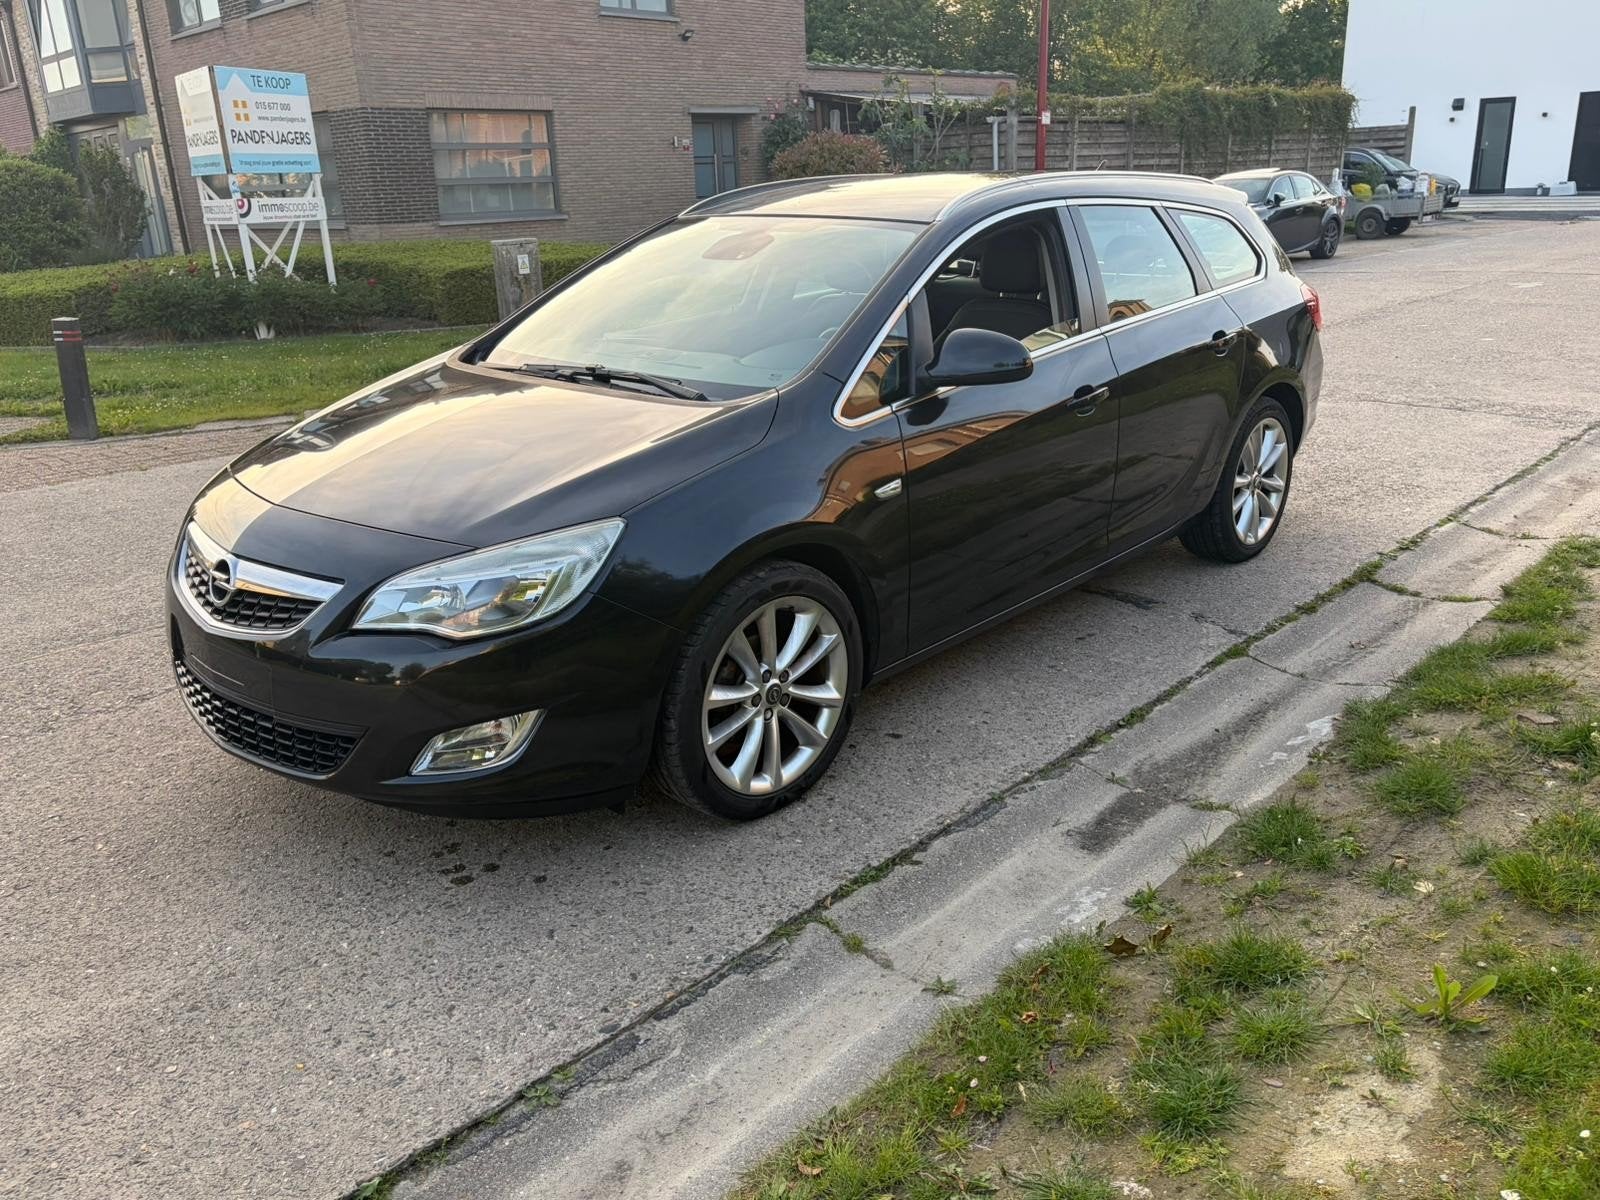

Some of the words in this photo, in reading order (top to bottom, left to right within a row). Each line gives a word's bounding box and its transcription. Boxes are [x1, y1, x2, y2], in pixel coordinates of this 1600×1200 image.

[250, 74, 263, 88] TE
[264, 76, 291, 90] KOOP
[255, 101, 267, 110] 015
[267, 102, 279, 111] 677
[280, 103, 291, 112] 000
[257, 115, 306, 123] www.pandenjagers.be
[257, 200, 319, 214] immoscoop.be
